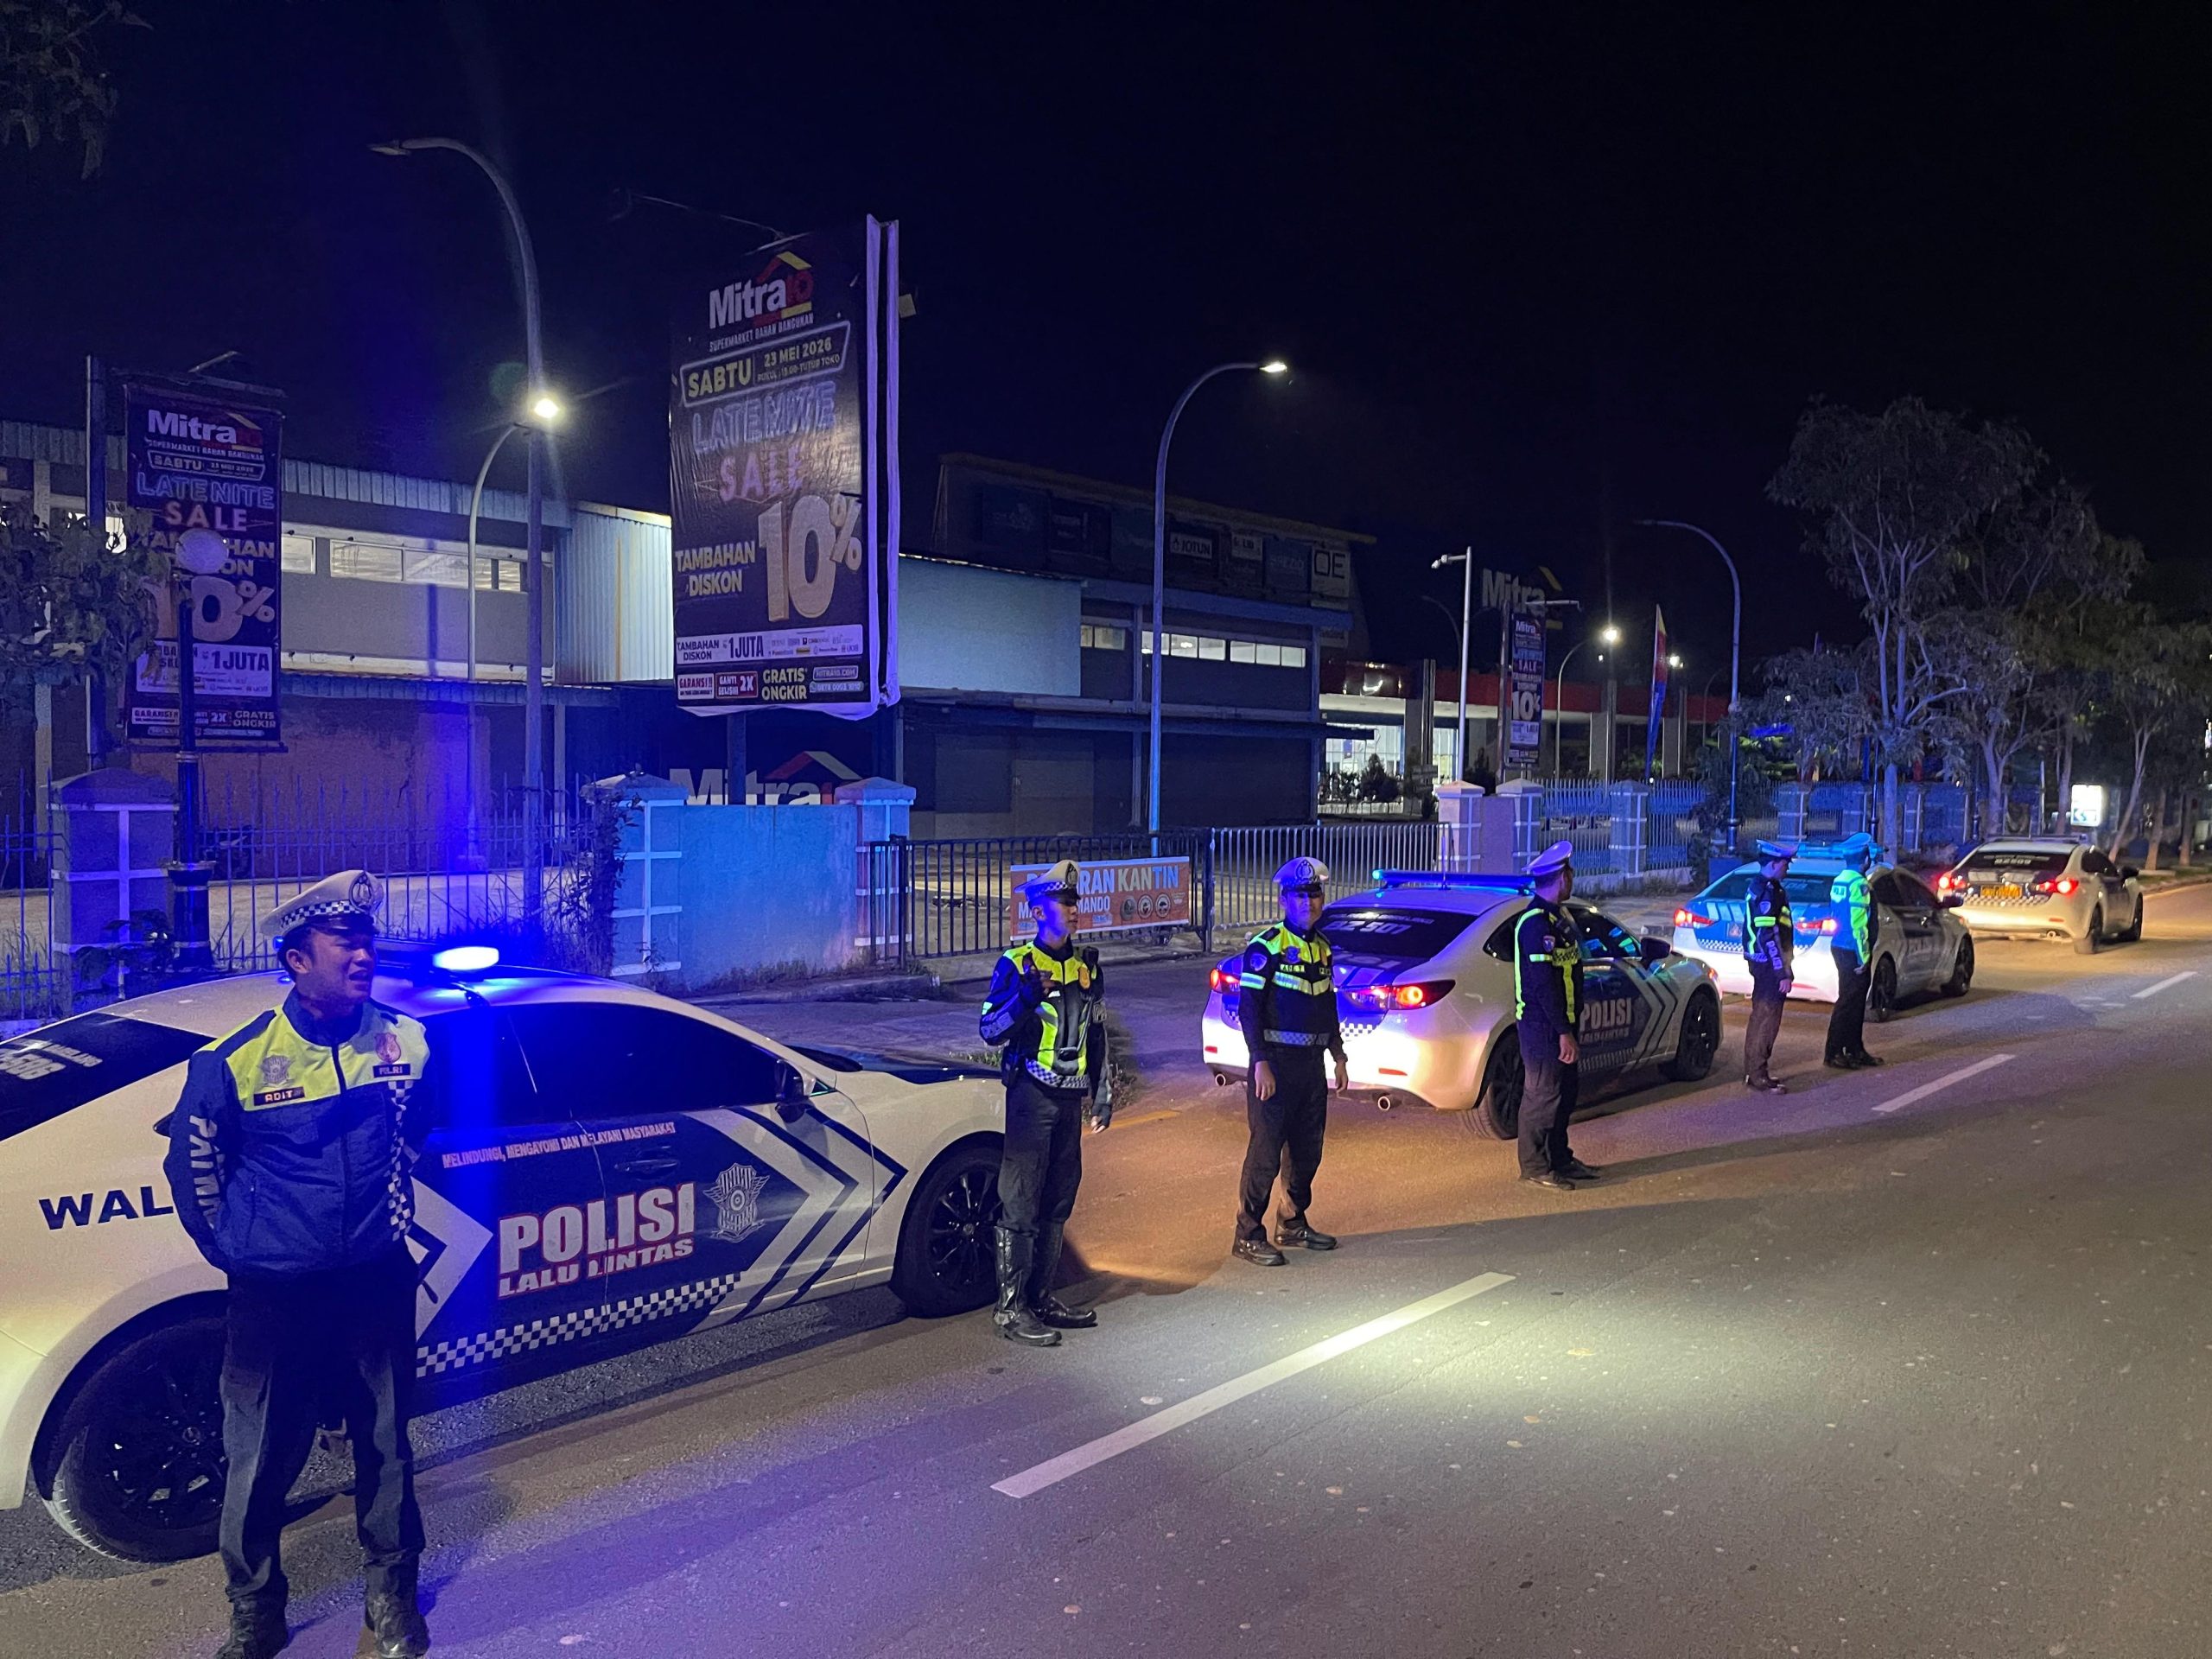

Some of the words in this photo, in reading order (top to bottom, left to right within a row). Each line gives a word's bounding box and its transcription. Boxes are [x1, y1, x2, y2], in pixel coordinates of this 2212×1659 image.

[709, 330, 753, 353] SUPERMARKET
[764, 351, 777, 368] 23
[779, 346, 800, 362] MEI
[802, 336, 831, 358] 2026
[688, 358, 752, 397] SABTU
[154, 454, 202, 471] SABTU
[721, 444, 803, 502] SALE
[137, 472, 207, 503] LATE
[211, 480, 275, 509] NITE
[165, 500, 247, 531] SALE
[675, 540, 756, 573] TAMBAHAN
[758, 494, 862, 622] 10%
[1180, 539, 1211, 555] JOTUN
[688, 569, 742, 597] DISKON
[677, 639, 719, 652] TAMBAHAN
[683, 650, 712, 661] DISKON
[740, 676, 754, 691] 2X
[761, 684, 808, 701] ONGKIR
[210, 713, 227, 722] 2X
[234, 710, 275, 720] GRATIS
[1512, 691, 1541, 721] 10%
[232, 719, 276, 728] ONGKIR
[1118, 865, 1179, 892] KANTIN
[1580, 997, 1632, 1032] POLISI
[264, 1090, 294, 1103] ADIT
[442, 1146, 506, 1169] MELINDUNGI,
[505, 1137, 561, 1160] MENGAYOMI
[562, 1135, 580, 1150] DAN
[581, 1130, 622, 1147] MELAYANI
[623, 1122, 676, 1141] MASYARAKAT
[499, 1182, 696, 1275] POLISI
[499, 1262, 580, 1298] LALU
[588, 1237, 695, 1279] LINTAS
